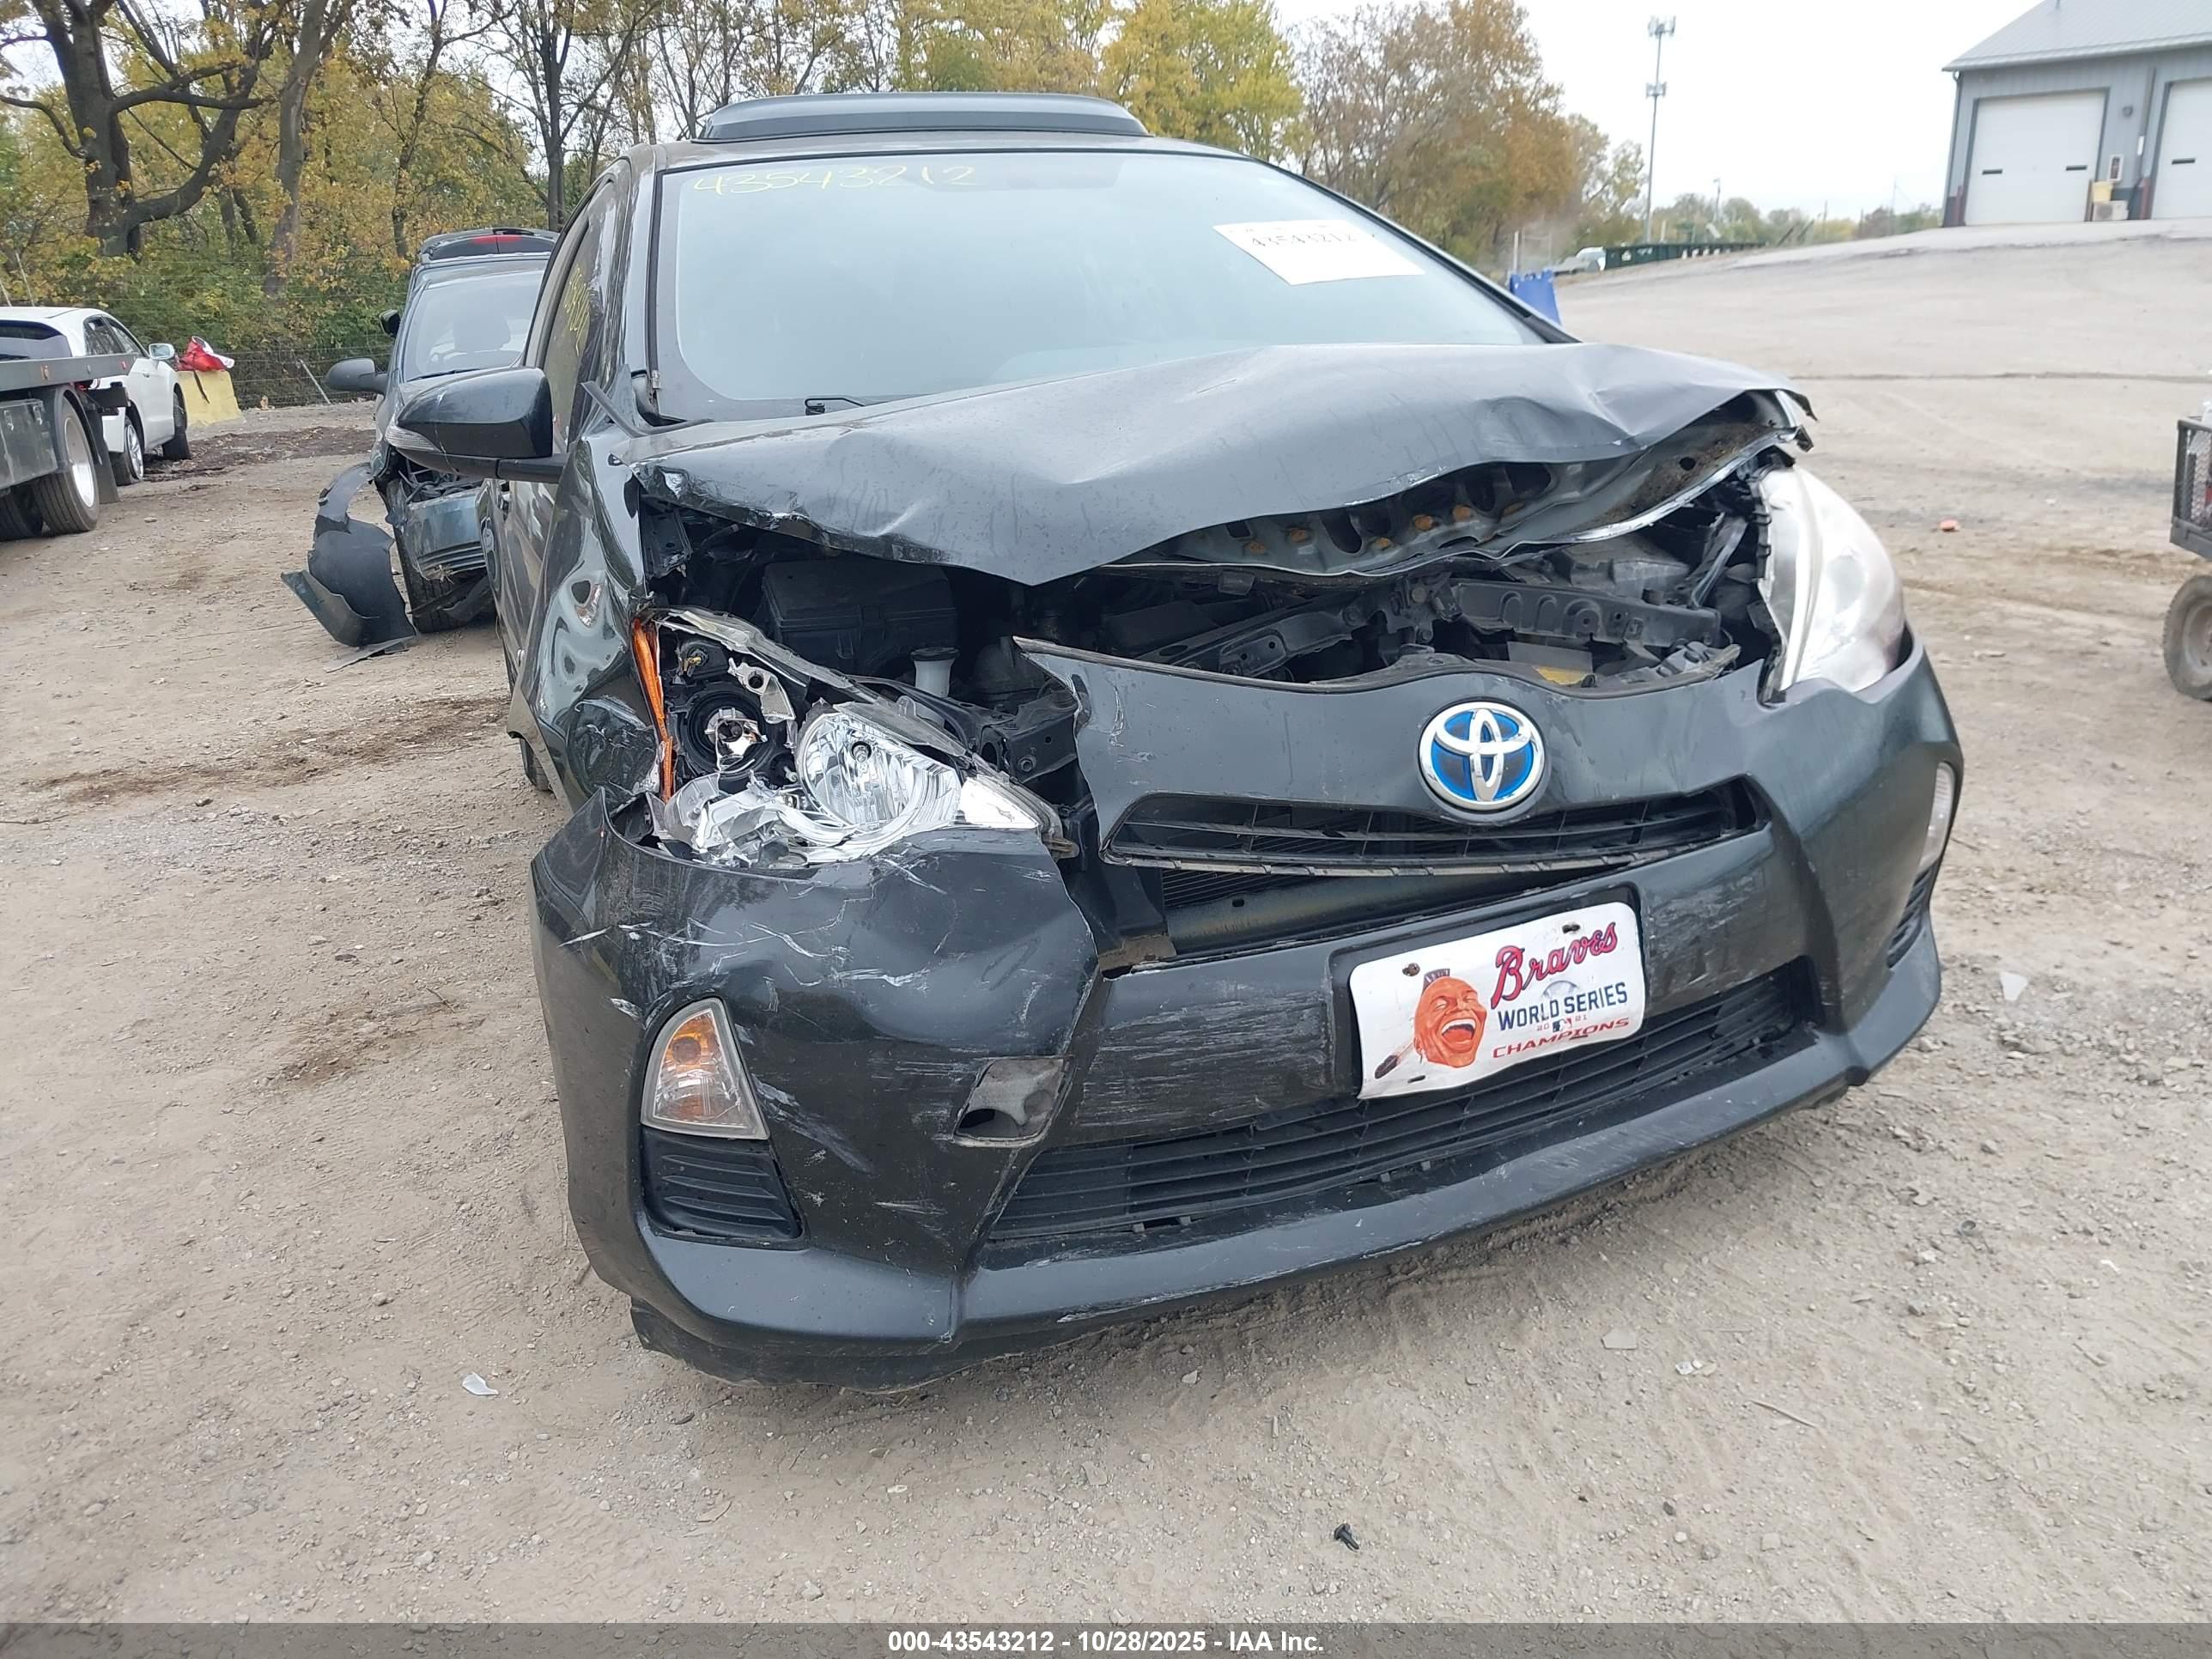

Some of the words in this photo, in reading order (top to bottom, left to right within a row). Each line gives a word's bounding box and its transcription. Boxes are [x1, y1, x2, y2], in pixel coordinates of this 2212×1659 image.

[694, 165, 984, 195] 43543212
[1491, 921, 1619, 1009] Braves
[1498, 1000, 1559, 1030] WORLD
[1564, 981, 1628, 1014] SERIES
[1492, 1017, 1630, 1058] CHAMPIONS
